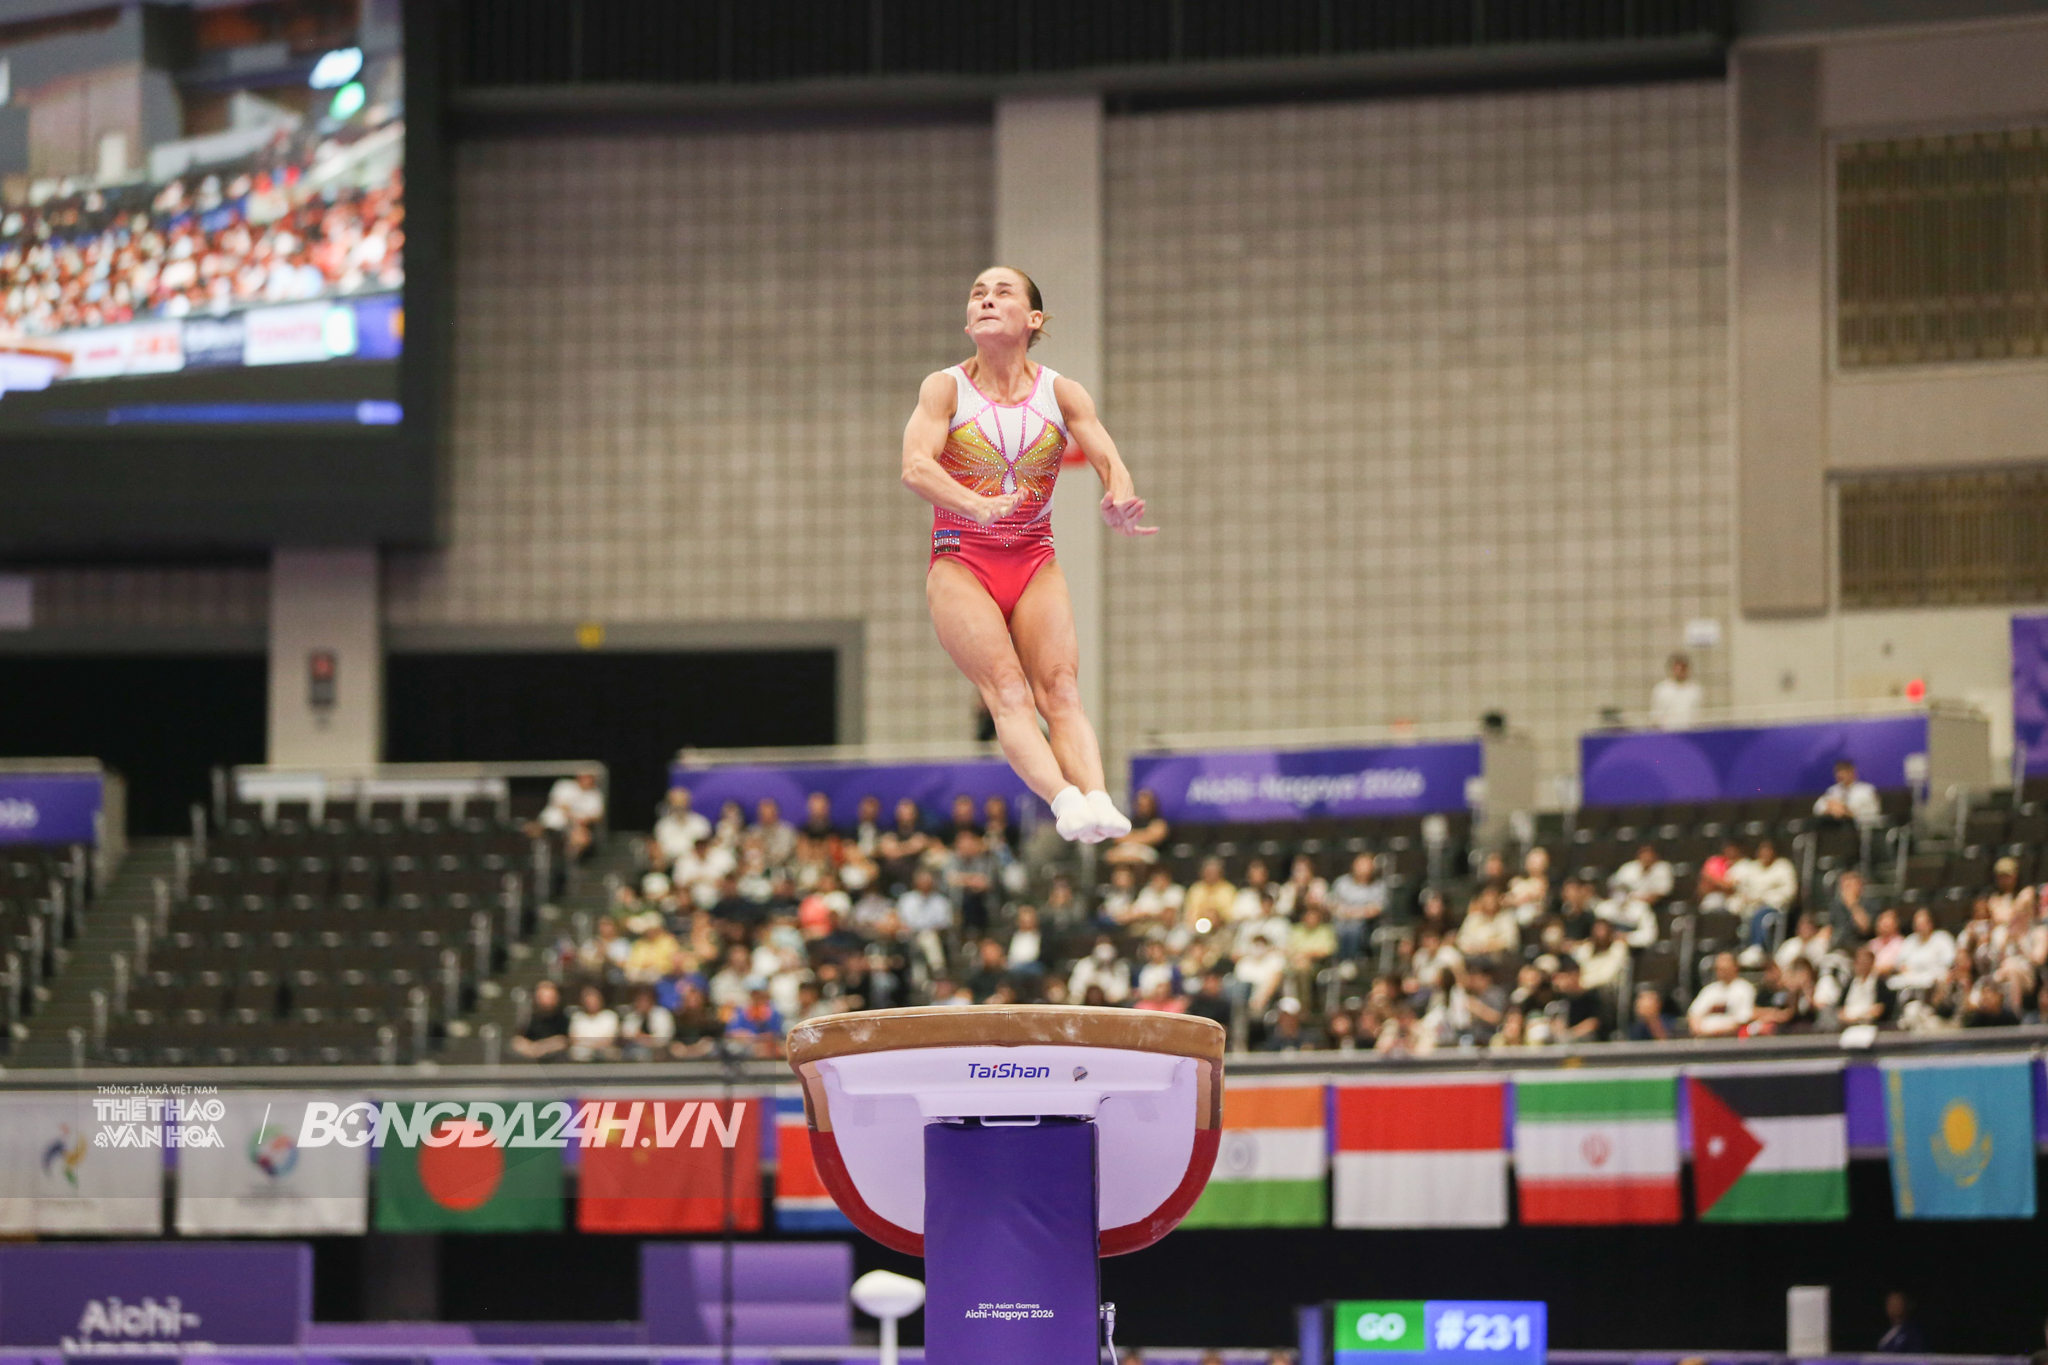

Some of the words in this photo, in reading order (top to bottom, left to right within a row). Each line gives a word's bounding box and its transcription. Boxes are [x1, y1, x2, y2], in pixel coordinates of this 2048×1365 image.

[968, 1063, 1050, 1078] TaiShan
[78, 1296, 202, 1338] Aichi-
[965, 1310, 1029, 1320] Aichi-Nagoya
[1031, 1310, 1054, 1318] 2026
[1356, 1312, 1407, 1342] GO
[1435, 1309, 1531, 1351] #231
